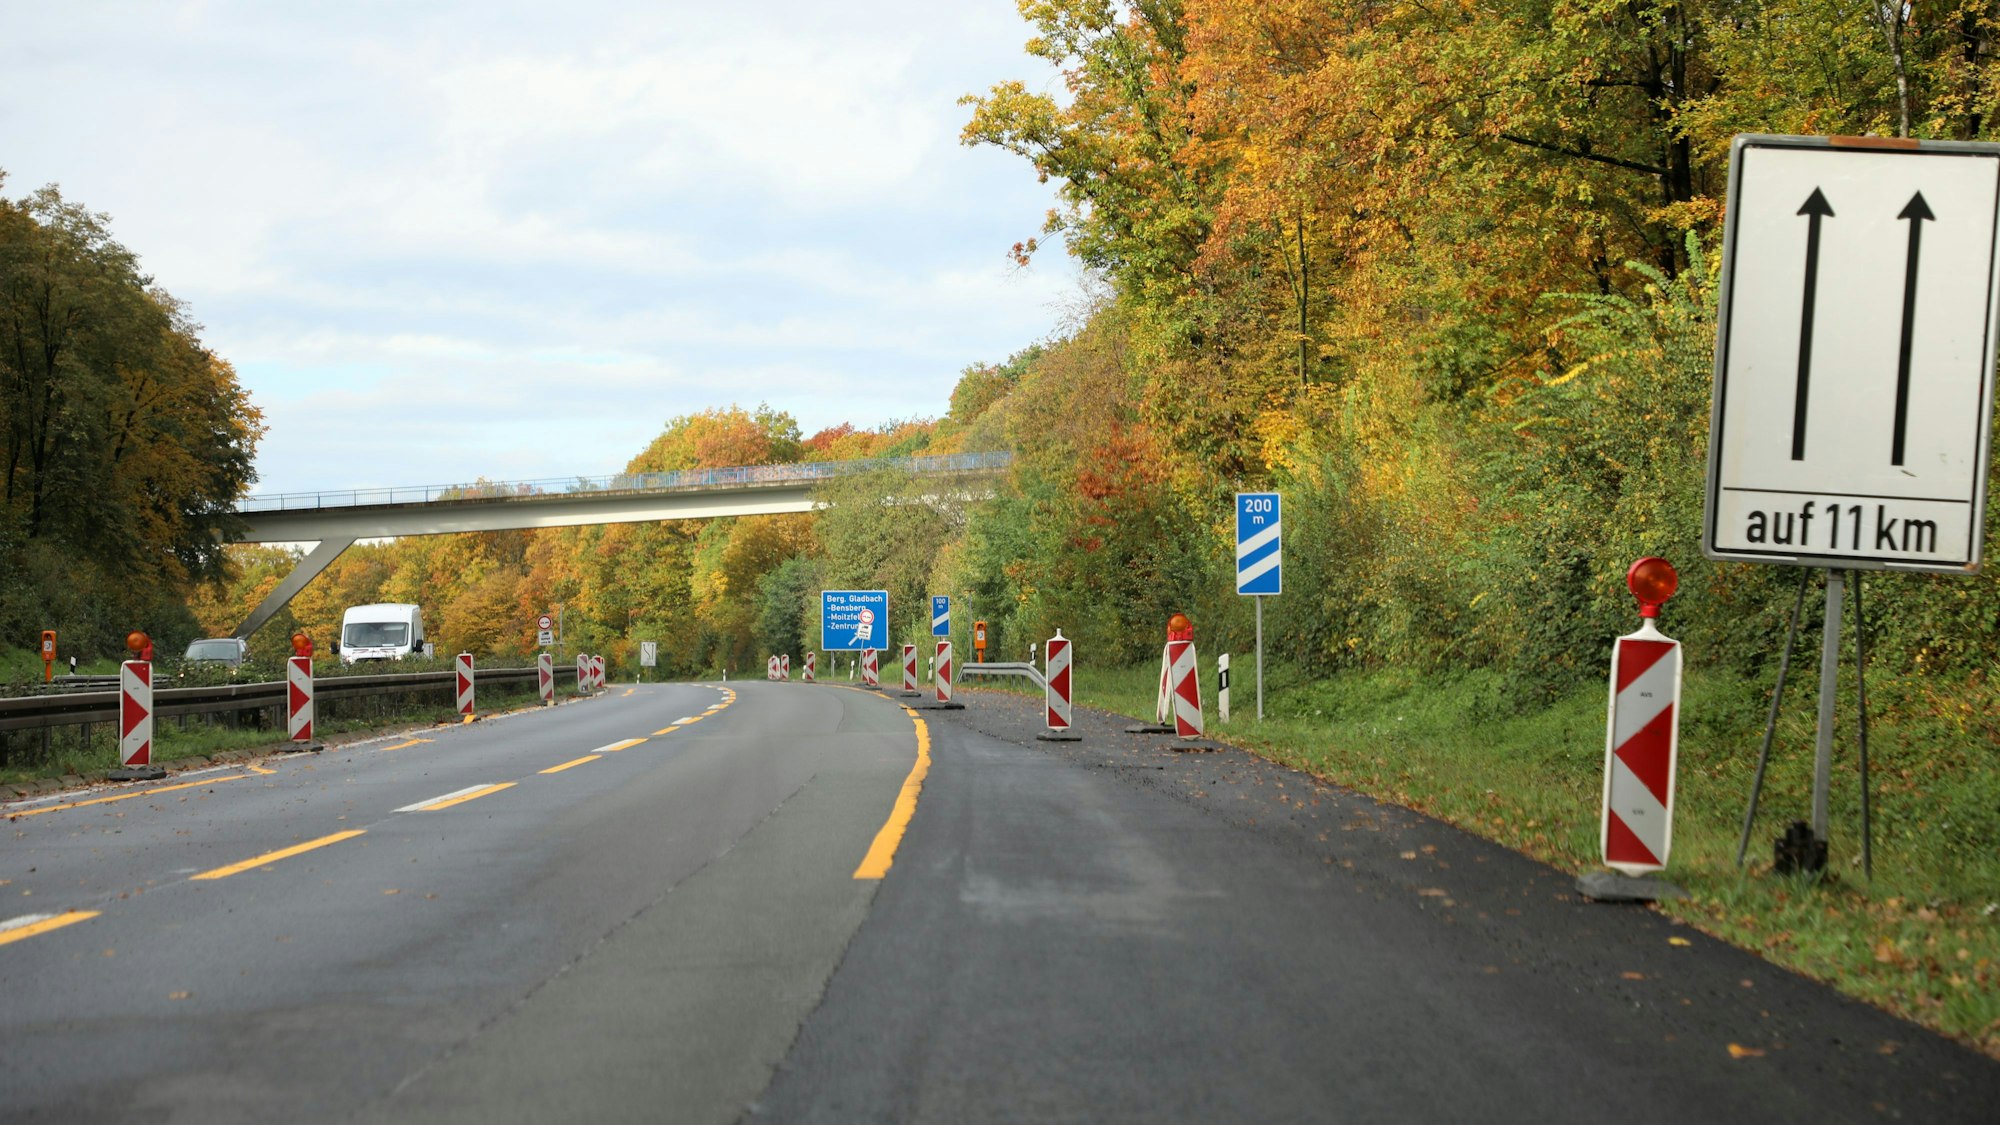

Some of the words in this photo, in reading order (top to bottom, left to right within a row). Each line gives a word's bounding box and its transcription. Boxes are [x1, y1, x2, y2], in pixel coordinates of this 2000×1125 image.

[1245, 499, 1272, 513] 200
[1253, 515, 1264, 524] m
[1746, 500, 1815, 546] auf
[1826, 503, 1863, 550] 11
[1876, 504, 1937, 553] km
[826, 595, 846, 604] Berg.
[849, 595, 883, 603] Gladbach
[827, 613, 861, 621] -Moitzfel
